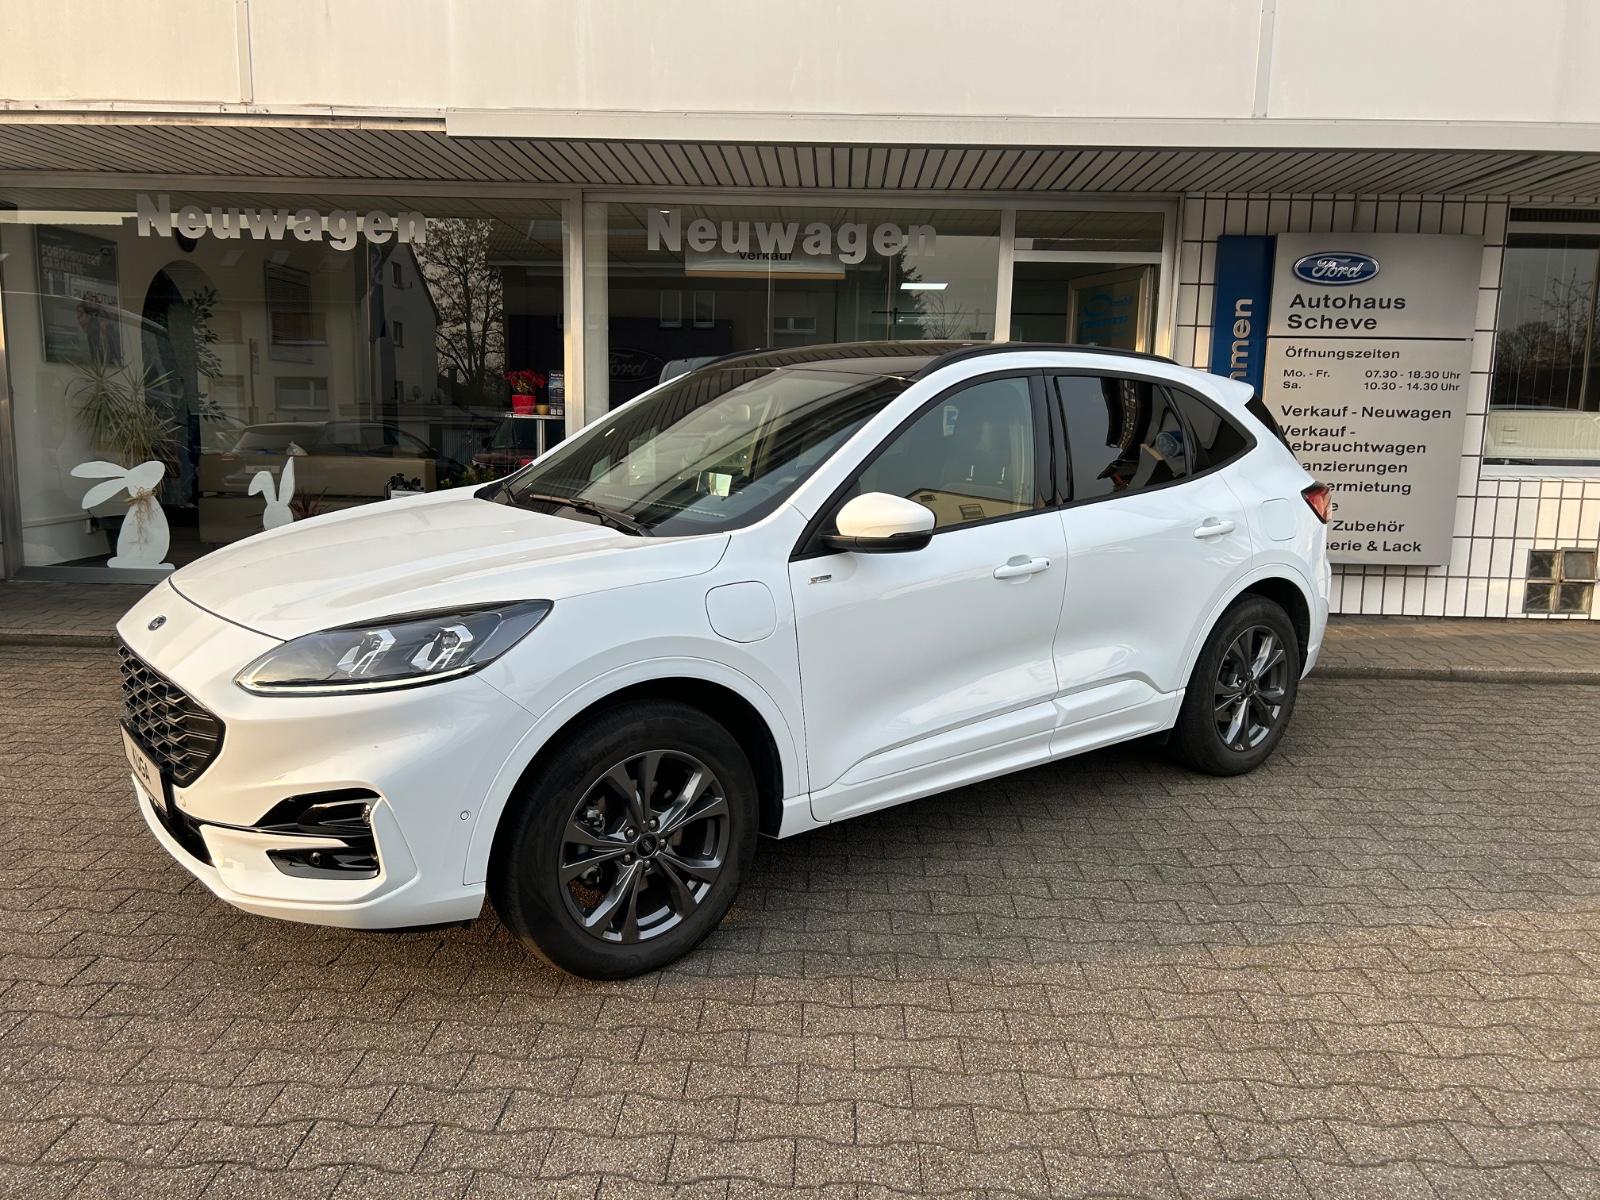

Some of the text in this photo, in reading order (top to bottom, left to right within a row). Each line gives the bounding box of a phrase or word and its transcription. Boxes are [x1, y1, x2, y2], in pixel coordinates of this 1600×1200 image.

[136, 194, 426, 251] Neuwagen
[647, 208, 937, 265] Neuwagen
[1311, 257, 1364, 278] Ford
[1289, 293, 1406, 310] Autohaus
[1287, 313, 1378, 330] Scheve
[1285, 346, 1400, 361] Öffnungszeiten
[1283, 369, 1306, 378] Mo.
[1316, 369, 1331, 378] Fr.
[1365, 370, 1398, 378] 07.30
[1408, 370, 1440, 380] 18.30
[1442, 371, 1461, 380] Uhr
[1283, 381, 1302, 389] Sa.
[1364, 382, 1396, 391] 10.30
[1407, 382, 1438, 391] 14.30
[1440, 382, 1460, 391] Uhr
[1281, 405, 1348, 417] Verkauf
[1361, 406, 1452, 421] Neuwagen
[1280, 425, 1346, 437] Verkauf
[1287, 440, 1426, 456] ebrauchtwagen
[1302, 460, 1408, 475] anzierungen
[1326, 481, 1412, 495] ermietung
[1332, 520, 1405, 532] Zubehör
[1367, 540, 1378, 551] &
[1383, 541, 1422, 552] Lack
